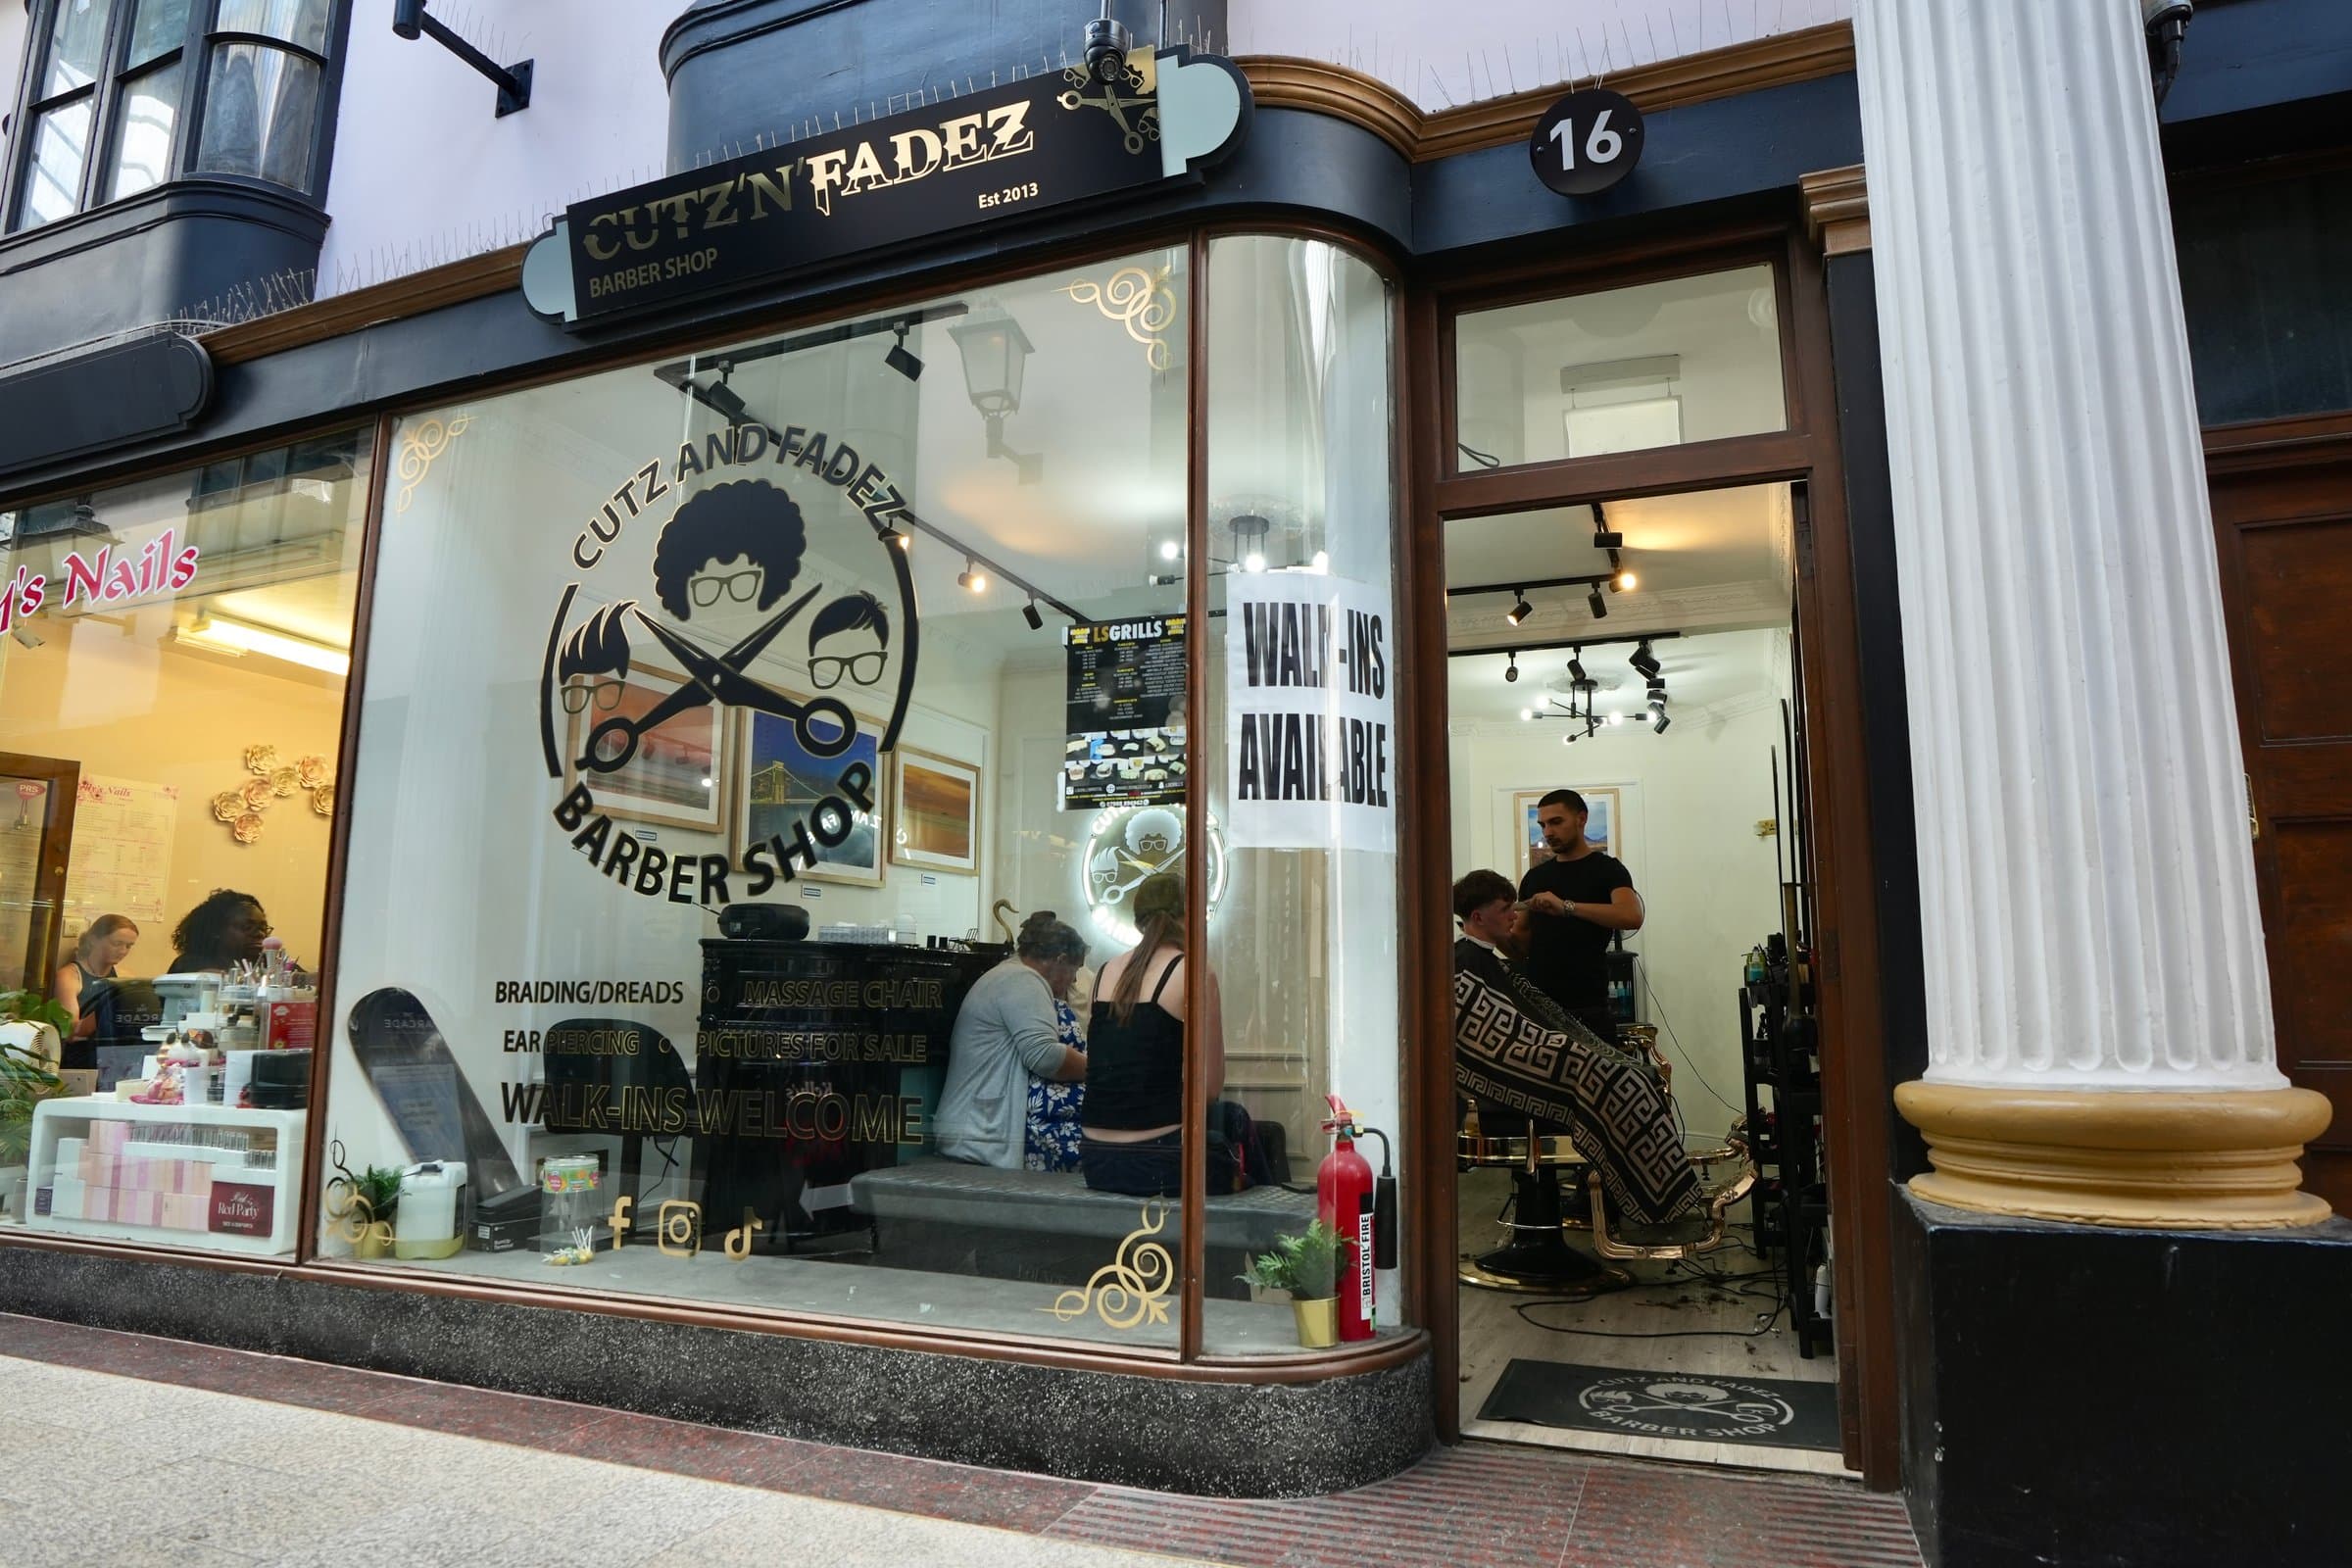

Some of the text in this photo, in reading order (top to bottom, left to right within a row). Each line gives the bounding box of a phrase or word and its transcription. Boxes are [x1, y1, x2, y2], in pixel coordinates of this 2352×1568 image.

[1549, 110, 1623, 172] 16
[979, 182, 1039, 209] Est 2013
[590, 247, 718, 299] BARBER SHOP
[572, 422, 906, 570] CUTZ AND FADEZ
[62, 527, 200, 610] Nails
[553, 761, 874, 905] BARBER SHOP
[495, 981, 684, 1004] BRAIDING/DREADS
[742, 980, 943, 1008] MASSAGE CHAIR
[503, 1030, 640, 1055] EAR PIERCING
[696, 1031, 927, 1063] PICTURES FOR SALE
[501, 1082, 688, 1133] WALK-INS
[697, 1089, 924, 1145] WELCOME
[1360, 1216, 1372, 1296] BRISTOL FIRE
[1597, 1377, 1651, 1387] CUTZ
[1711, 1380, 1782, 1398] FADEZ
[1588, 1410, 1778, 1438] BARBER SHOP
